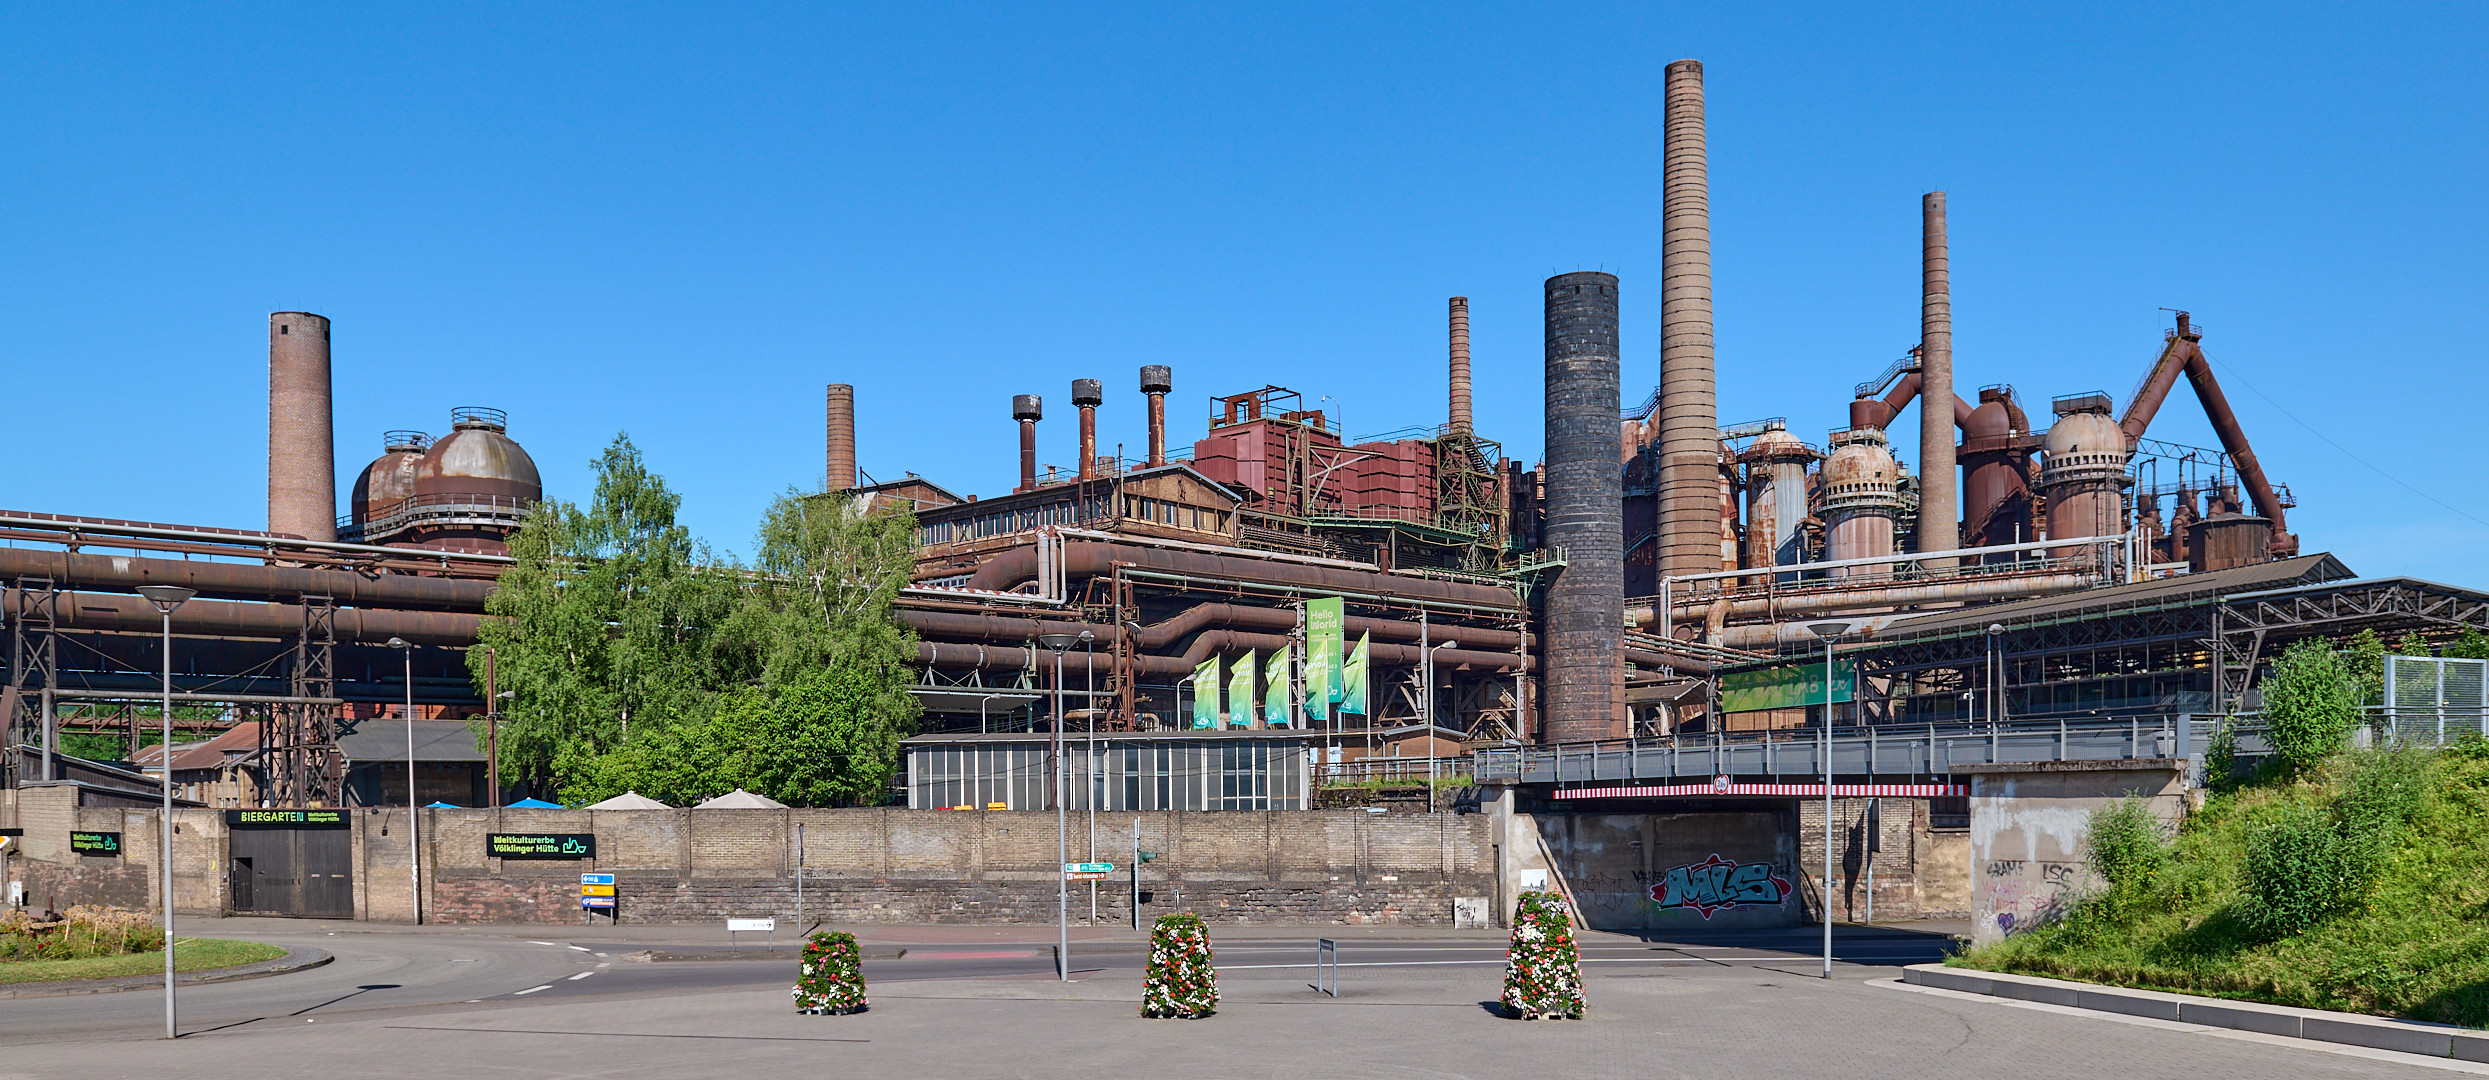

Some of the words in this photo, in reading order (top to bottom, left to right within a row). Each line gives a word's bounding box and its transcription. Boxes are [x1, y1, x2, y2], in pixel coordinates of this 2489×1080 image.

[1310, 609, 1333, 620] Hello
[1310, 618, 1337, 630] World
[1790, 674, 1819, 695] LAB
[241, 811, 304, 822] BIERGARTEN
[493, 835, 555, 844] Weltkulturerbe
[493, 844, 535, 854] Völklinger
[535, 844, 559, 853] Hütte
